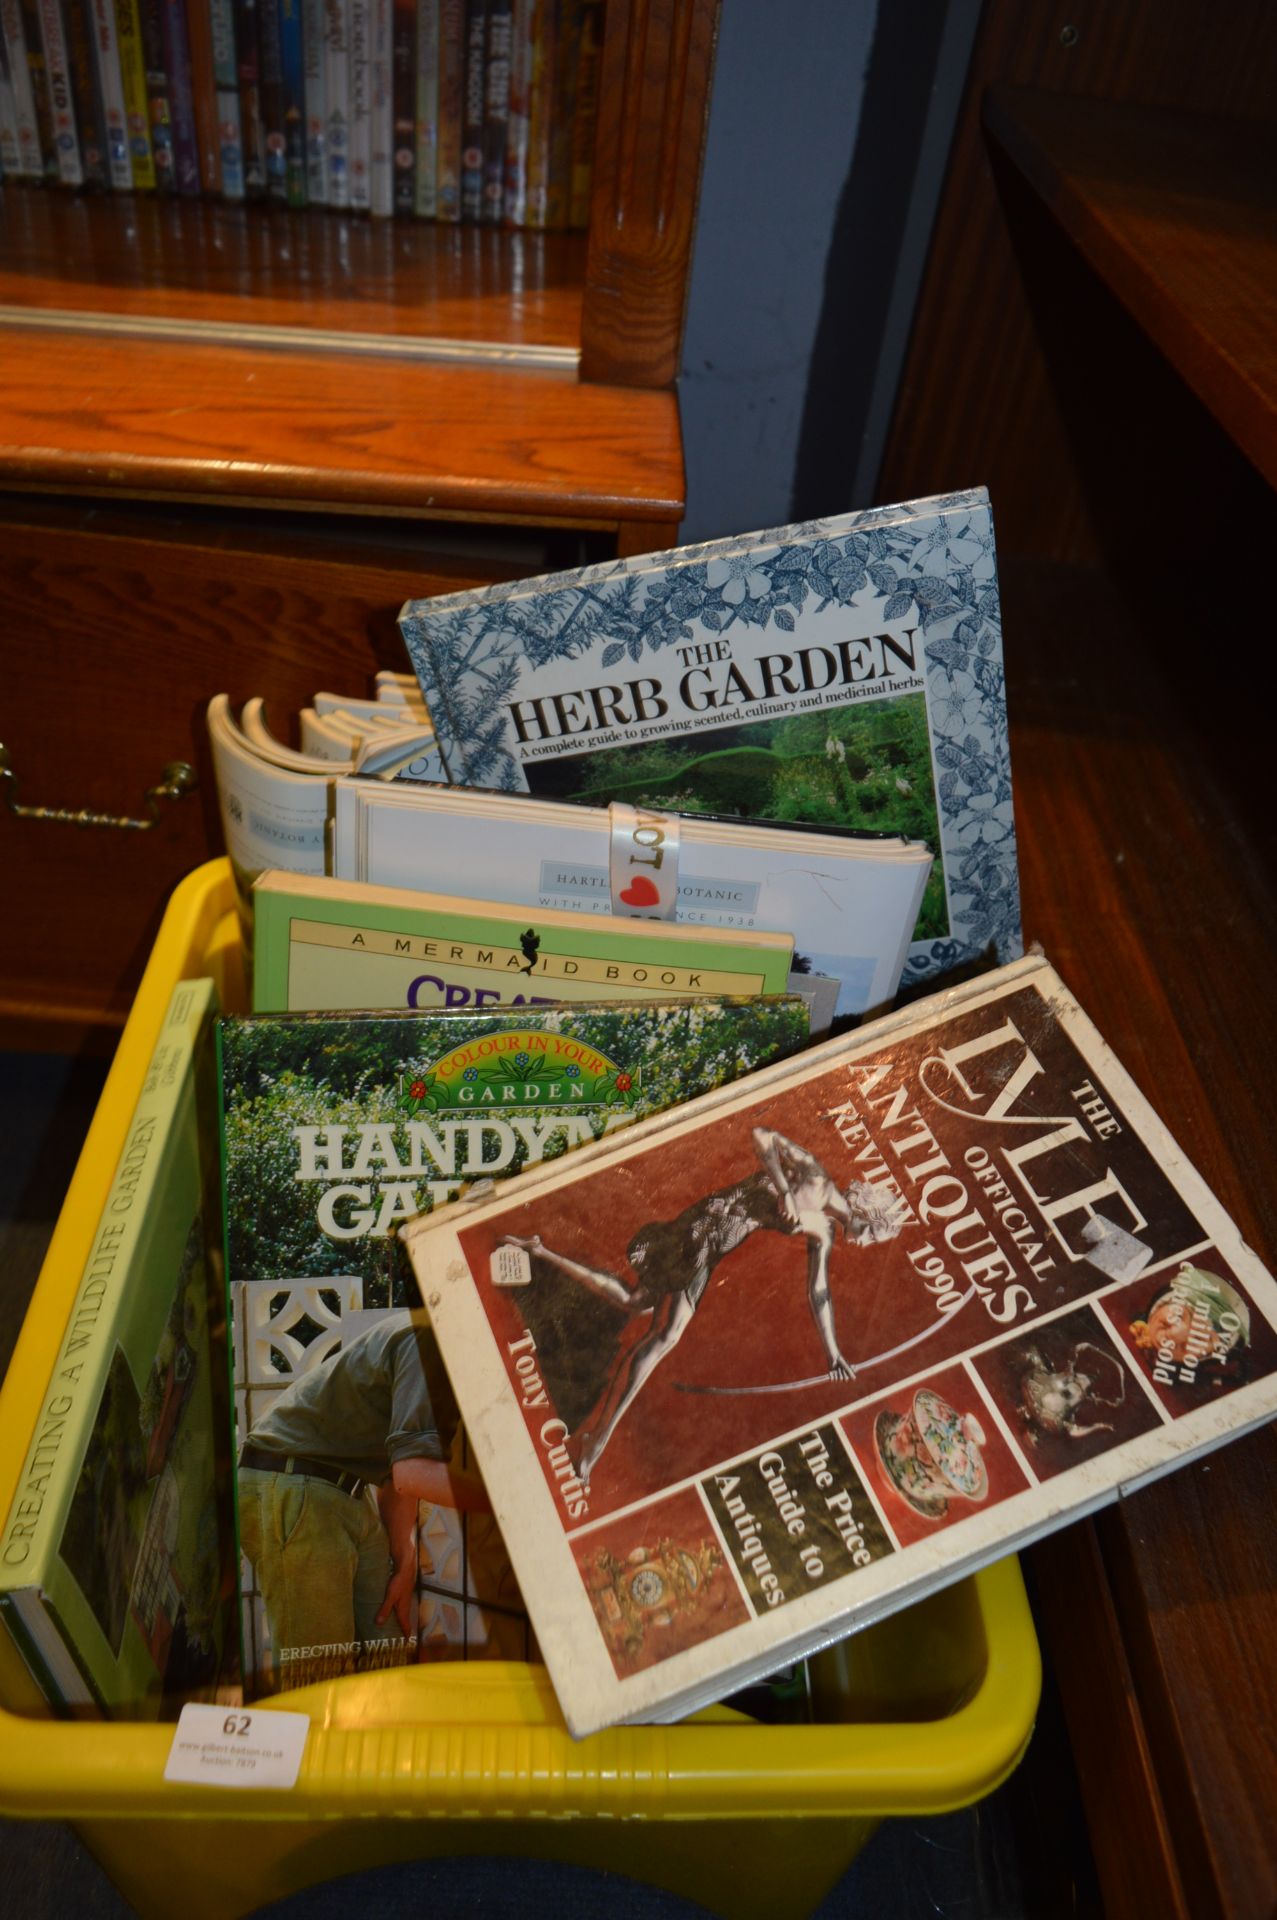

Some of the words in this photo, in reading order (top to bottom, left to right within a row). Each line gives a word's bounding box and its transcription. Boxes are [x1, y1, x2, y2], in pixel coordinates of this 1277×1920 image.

[53, 72, 69, 109] KID
[508, 677, 669, 744] HERB
[679, 628, 918, 713] GARDEN
[676, 639, 733, 669] THE
[519, 746, 530, 758] A
[531, 738, 585, 758] complete
[587, 729, 621, 748] guide
[623, 727, 638, 739] to
[640, 718, 692, 738] growing
[694, 707, 745, 727] scented,
[745, 699, 797, 719] culinary
[799, 692, 823, 708] and
[825, 682, 887, 702] medicinal
[888, 675, 925, 692] herbs
[539, 897, 581, 910] WITH
[718, 912, 756, 927] 1938
[352, 932, 365, 946] A
[395, 939, 578, 976] MERMAID
[606, 965, 702, 988] BOOK
[439, 1034, 521, 1077] COLOUR
[527, 1036, 549, 1052] IN
[553, 1040, 604, 1074] YOUR
[458, 1083, 585, 1101] GARDEN
[918, 1016, 1149, 1262] LYLE
[1071, 1079, 1122, 1143] THE
[111, 1115, 158, 1214] GARDEN
[825, 1099, 922, 1230] REVIEW
[906, 1240, 964, 1314] 1990
[848, 1062, 1038, 1325] ANTIQUES
[963, 1145, 1058, 1283] OFFICIAL
[63, 1222, 125, 1359] WILDLIFE
[61, 1361, 85, 1384] A
[1152, 1337, 1177, 1387] sold
[1178, 1299, 1211, 1384] million
[1211, 1311, 1241, 1366] Over
[507, 1328, 550, 1411] Tony
[539, 1417, 592, 1520] Curtis
[3, 1394, 73, 1566] CREATING
[758, 1451, 807, 1537] Guide
[799, 1542, 825, 1580] to
[799, 1430, 834, 1490] The
[828, 1488, 872, 1567] Price
[713, 1472, 785, 1608] Antiques
[279, 1641, 362, 1661] ERECTING
[365, 1635, 417, 1654] WALLS
[222, 1714, 252, 1737] 62
